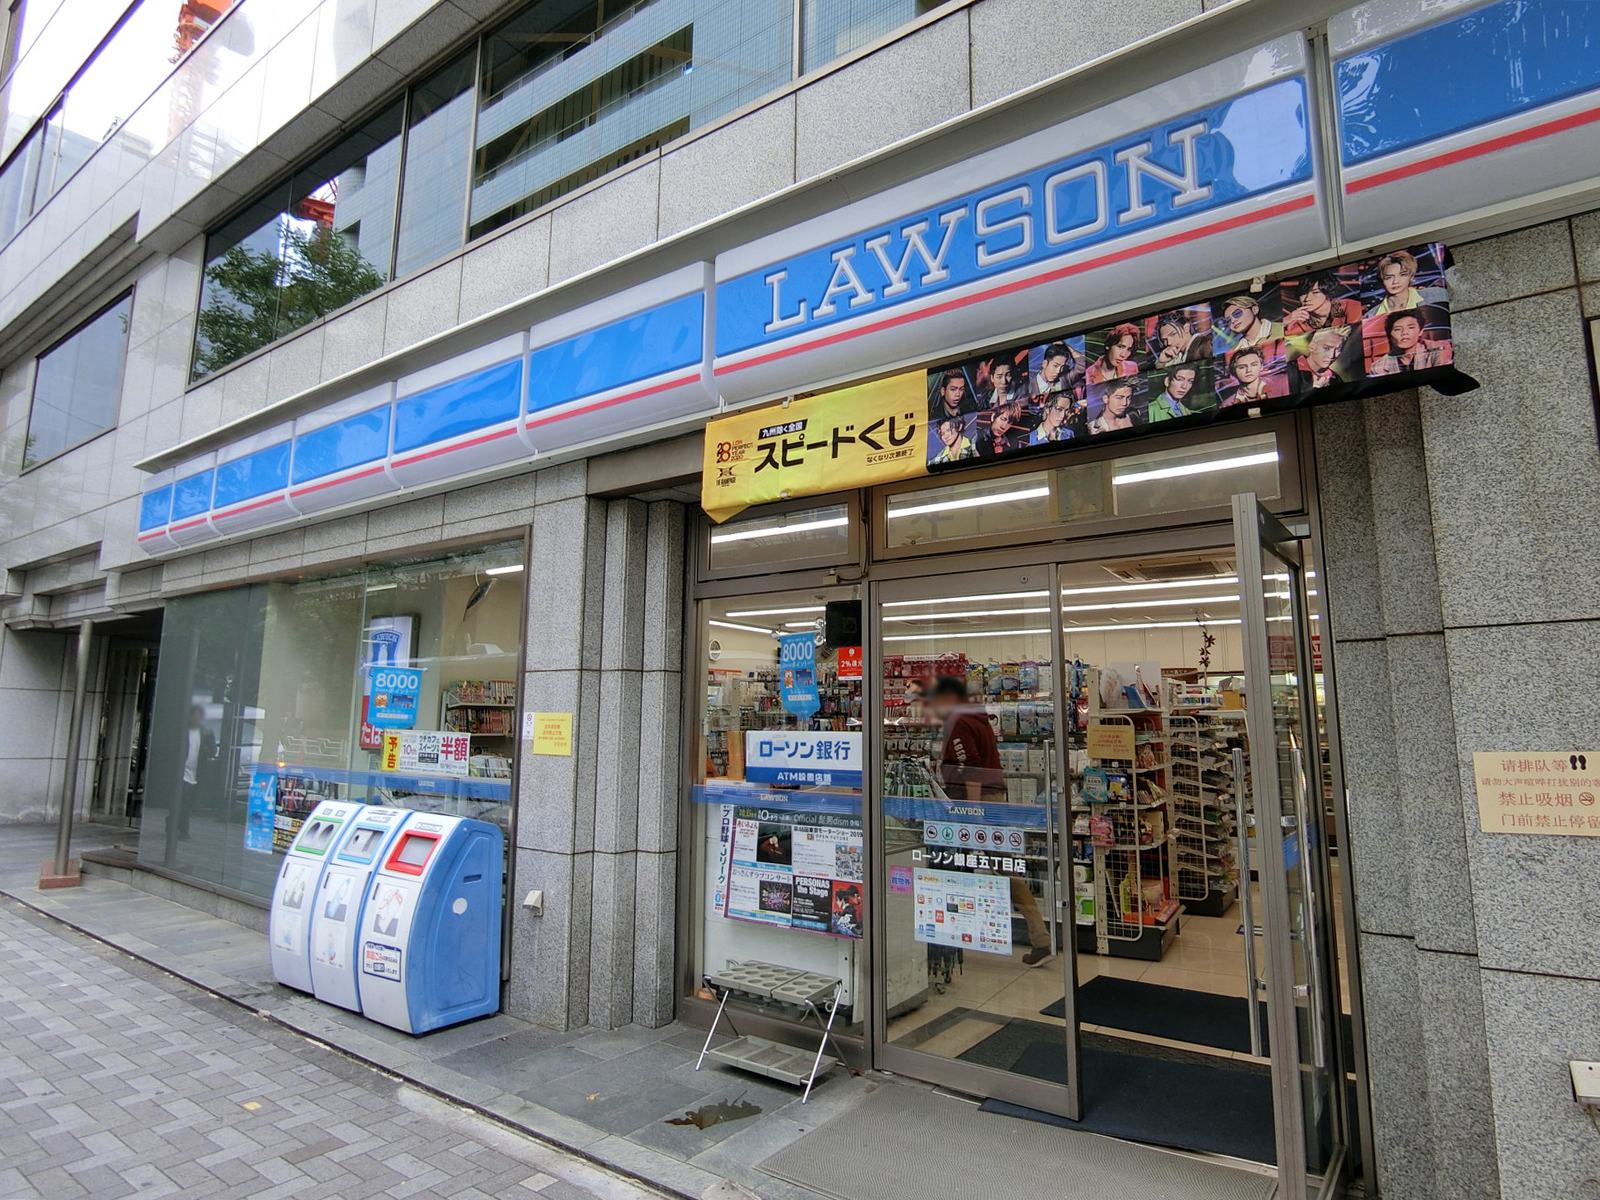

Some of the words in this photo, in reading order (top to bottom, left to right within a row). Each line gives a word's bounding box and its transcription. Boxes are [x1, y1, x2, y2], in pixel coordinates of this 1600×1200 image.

[764, 119, 1213, 335] LAWSON
[762, 421, 804, 437] 九州除く全国
[731, 442, 753, 450] PERFECT
[754, 413, 916, 473] スピードくじ
[867, 448, 914, 463] なくなり次第終了
[783, 641, 812, 662] 8000
[375, 673, 418, 690] 8000
[387, 737, 398, 768] 予告
[441, 736, 468, 761] 半額
[760, 740, 850, 760] ローソン銀行
[1501, 759, 1568, 773] 请排队等
[777, 772, 832, 783] ATM設置店舗
[1498, 791, 1573, 807] 禁止吸烟
[947, 806, 985, 816] LAWSON
[912, 850, 1027, 874] ローソン銀座五丁目店
[797, 885, 808, 894] the
[809, 887, 829, 898] Stage
